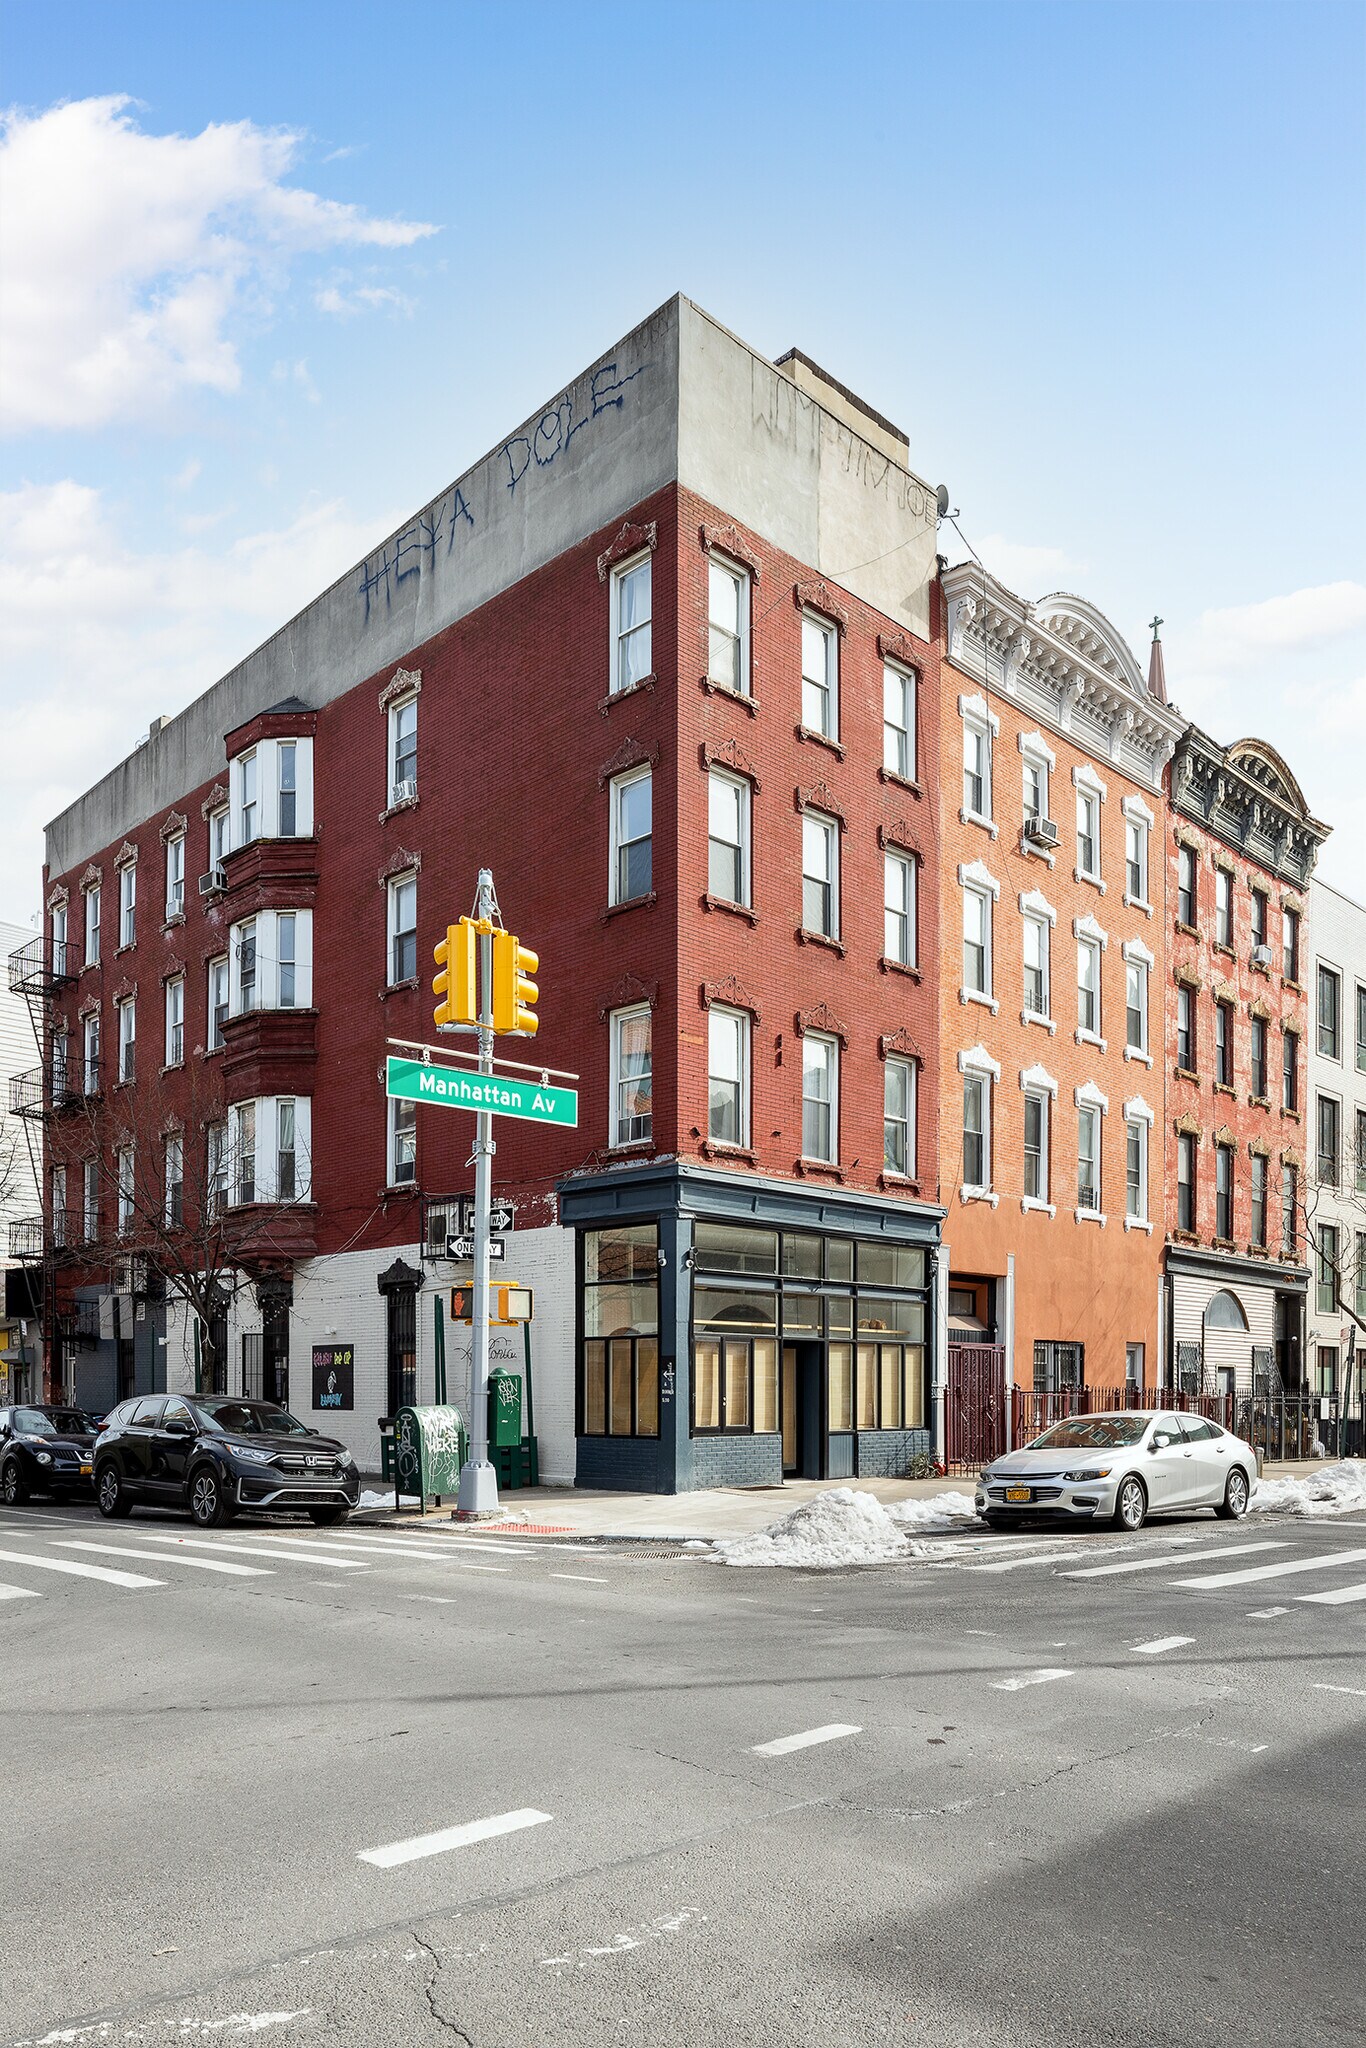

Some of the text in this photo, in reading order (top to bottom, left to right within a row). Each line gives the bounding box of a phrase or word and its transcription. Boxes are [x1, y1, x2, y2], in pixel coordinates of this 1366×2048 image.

[419, 1073, 556, 1114] Manhattan Av
[491, 1215, 507, 1225] WAY
[457, 1242, 474, 1253] ONE
[425, 1436, 459, 1454] HERE
